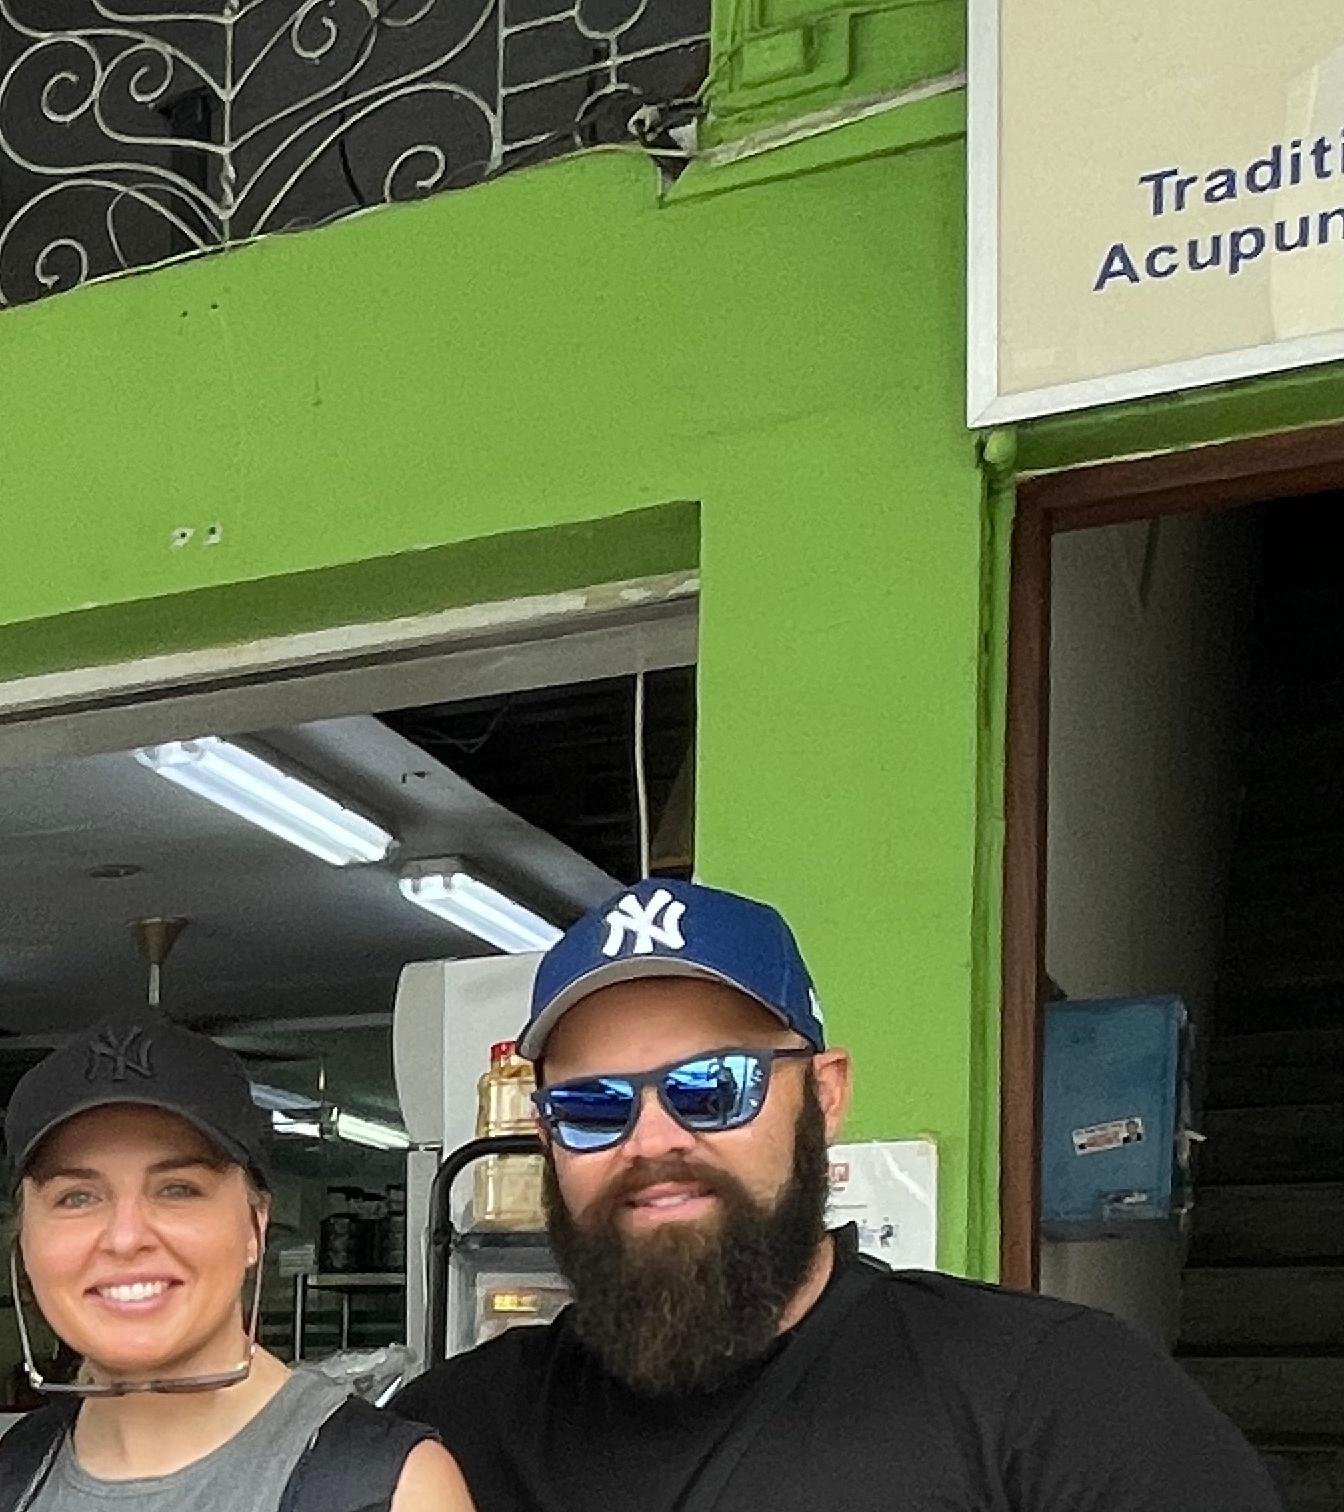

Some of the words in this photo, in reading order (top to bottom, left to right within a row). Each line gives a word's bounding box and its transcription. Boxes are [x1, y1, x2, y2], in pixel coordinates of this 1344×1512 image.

[1093, 207, 1344, 291] Acupun
[602, 888, 687, 957] NY
[85, 1025, 154, 1084] NY
